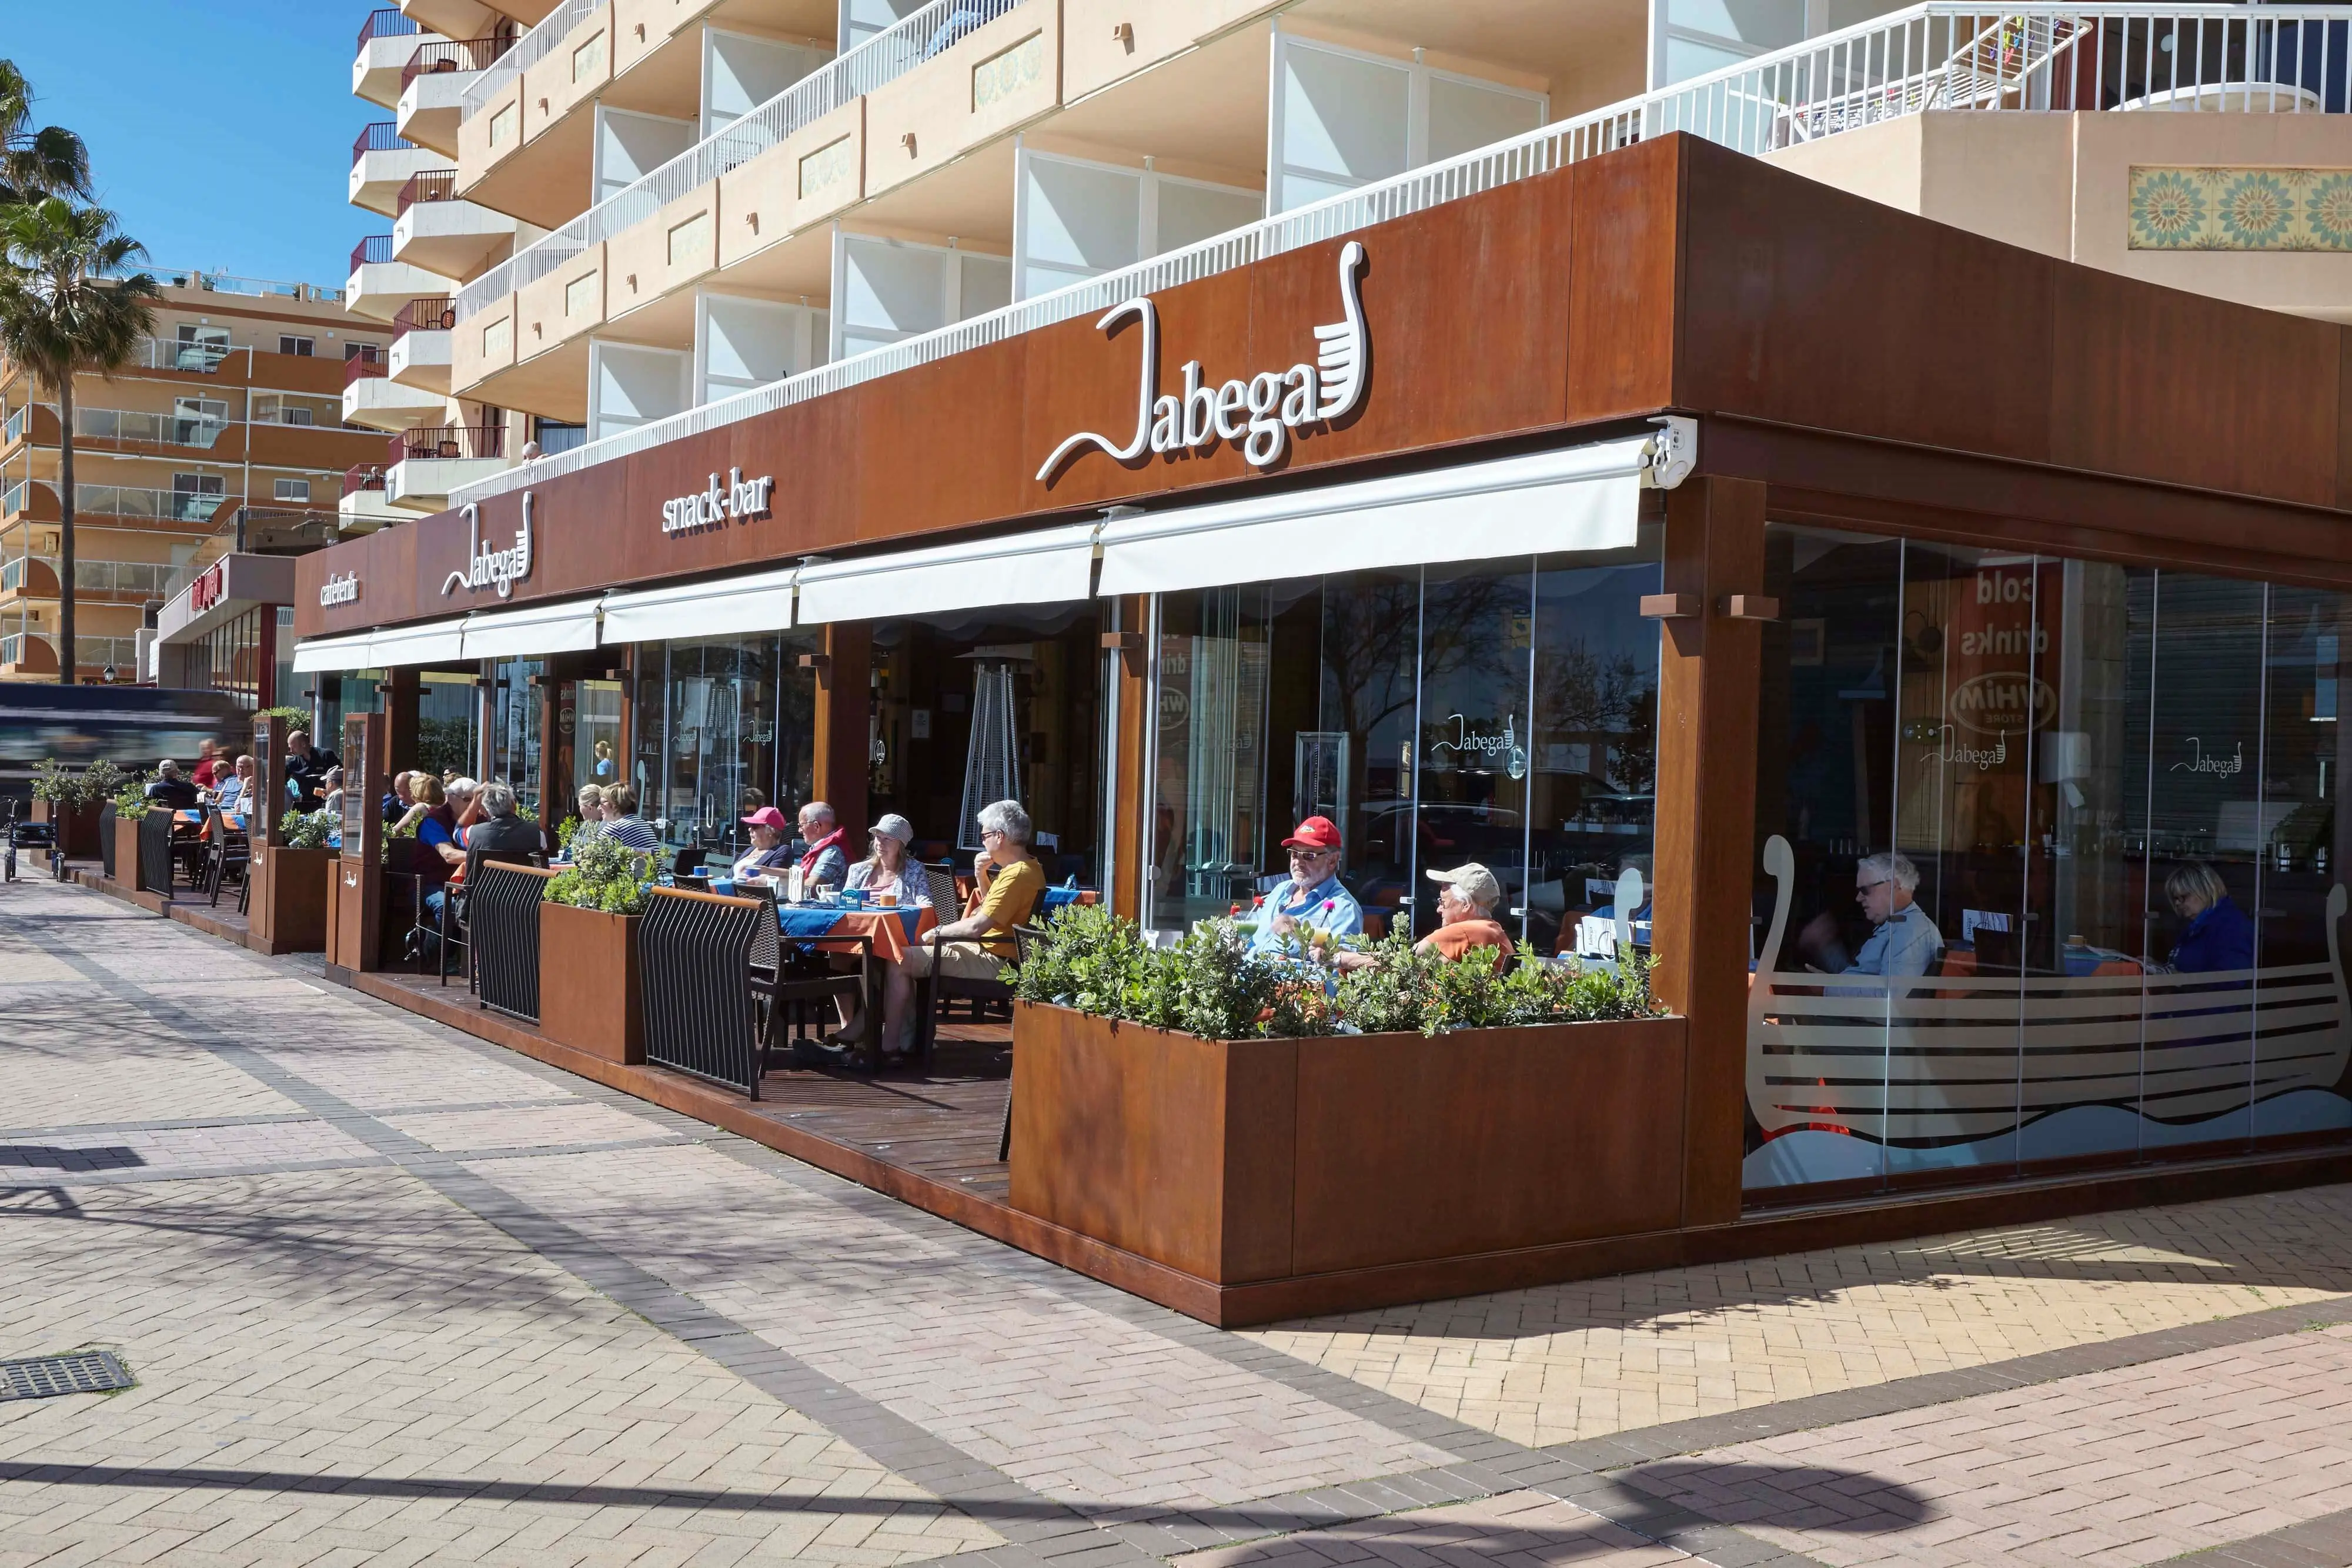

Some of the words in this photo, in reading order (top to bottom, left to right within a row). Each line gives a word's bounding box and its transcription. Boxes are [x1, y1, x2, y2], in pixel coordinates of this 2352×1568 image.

[1036, 297, 1321, 480] Jabega
[662, 466, 772, 533] snack-bar
[441, 503, 517, 597] Jabega
[1431, 714, 1505, 757] Jabega
[1920, 724, 1997, 770] Jabega
[2170, 737, 2234, 778] Jabega
